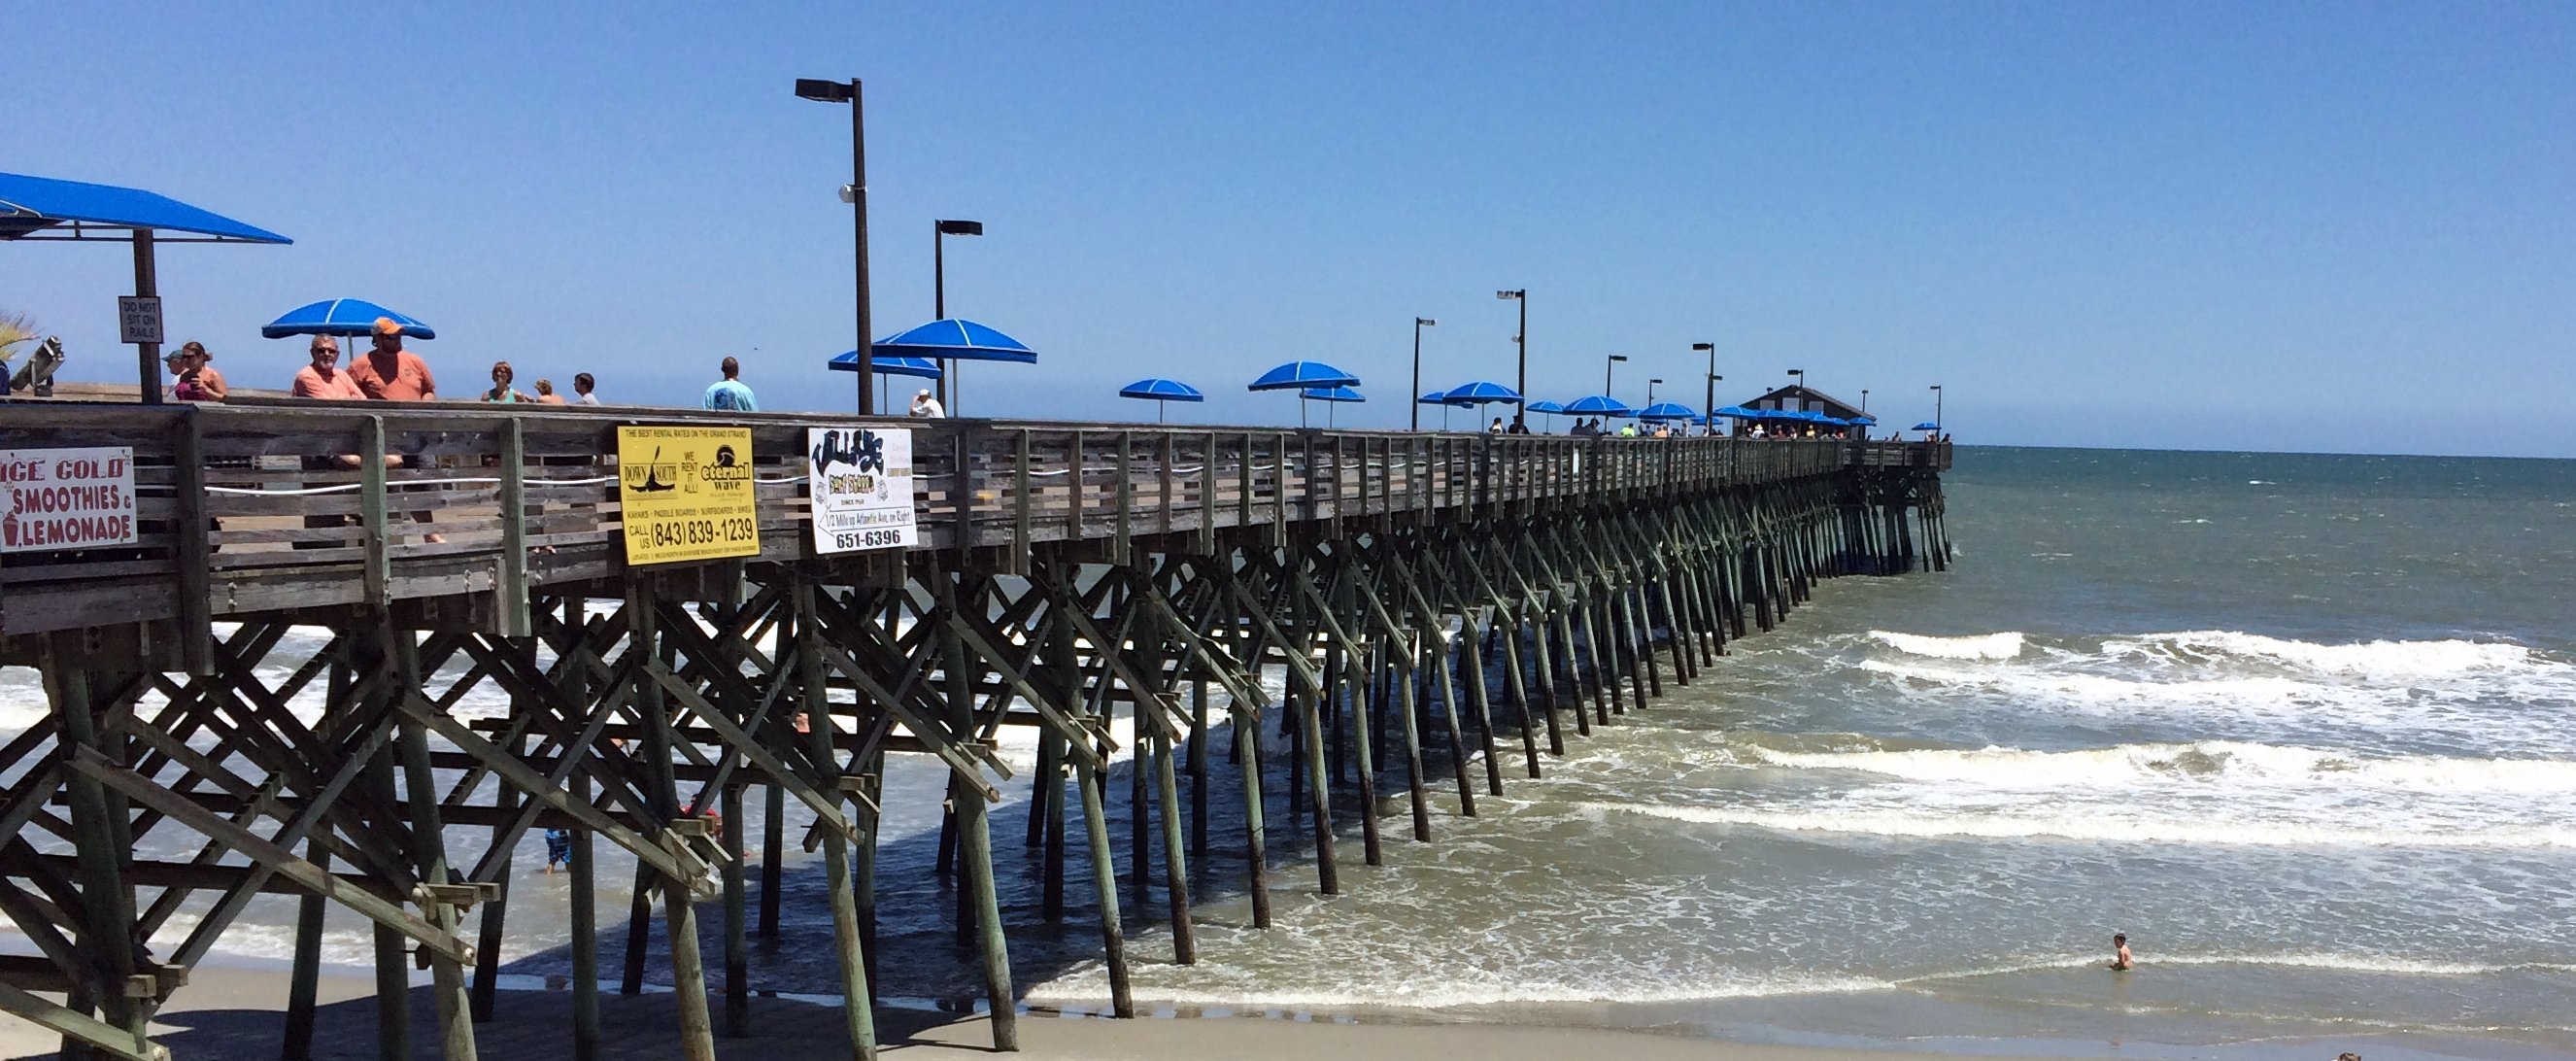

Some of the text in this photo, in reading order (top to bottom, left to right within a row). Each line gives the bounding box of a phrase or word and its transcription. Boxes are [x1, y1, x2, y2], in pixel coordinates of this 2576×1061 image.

[123, 301, 156, 313] DO NOT
[127, 314, 155, 325] SIT ON
[129, 326, 155, 337] RAILS
[684, 452, 695, 462] WE
[0, 456, 124, 482] ICE COLD
[681, 462, 698, 472] RENT
[701, 462, 750, 481] eternal
[625, 466, 677, 481] DOWN SOUTH
[688, 473, 693, 483] IT
[714, 482, 740, 491] wave
[13, 485, 120, 514] SMOOTHIES
[627, 510, 649, 519] KAYAKS
[22, 515, 131, 546] LEMONADE
[628, 526, 649, 536] CALL
[640, 538, 651, 549] US
[836, 530, 900, 549] 651-6396
